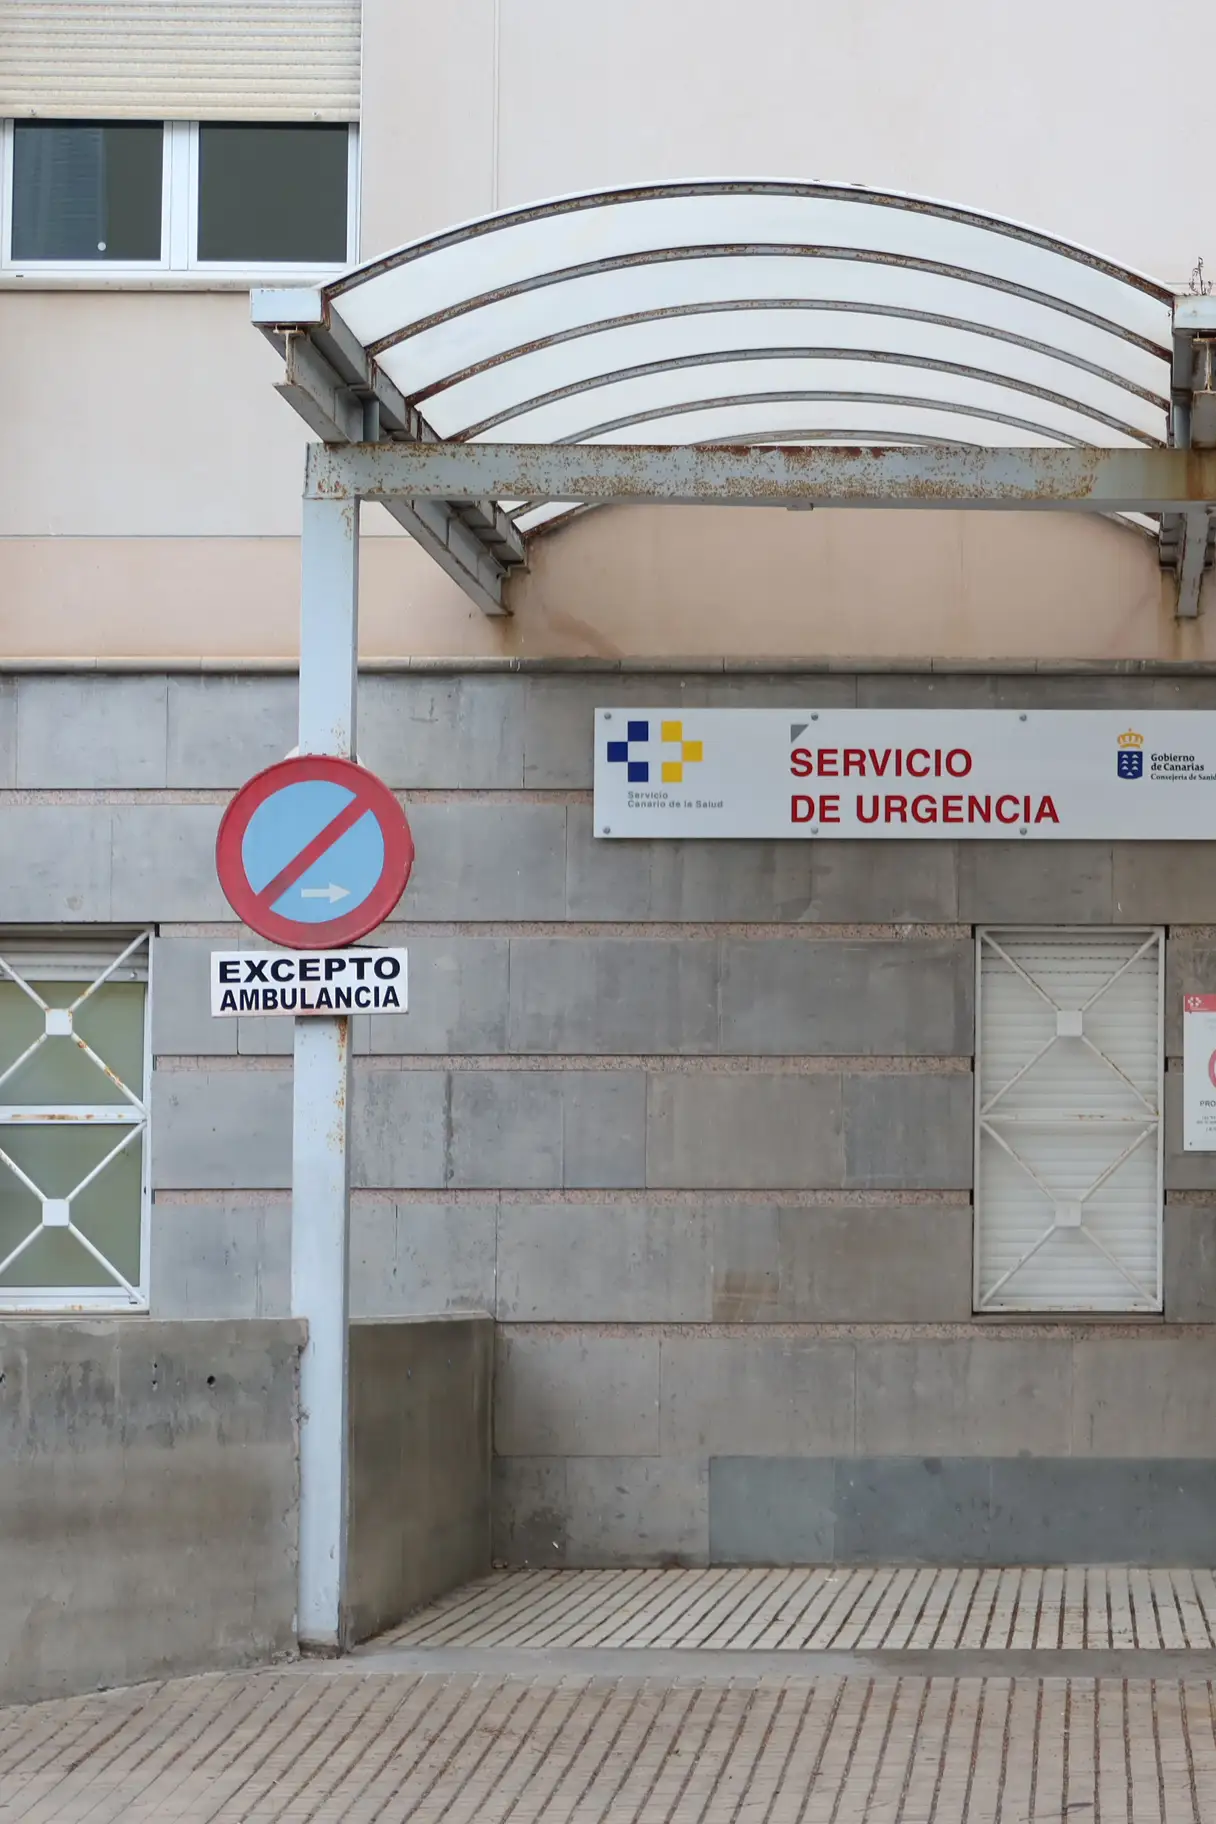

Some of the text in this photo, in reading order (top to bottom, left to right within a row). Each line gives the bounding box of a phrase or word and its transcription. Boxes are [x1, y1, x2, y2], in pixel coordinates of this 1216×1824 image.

[790, 748, 973, 777] SERVICIO
[1150, 753, 1195, 762] Gobierno
[1150, 763, 1205, 771] de Canarias
[627, 791, 668, 799] Servicio
[627, 800, 724, 808] Canario de la Salud
[791, 794, 1060, 824] DE URGENCIA
[219, 956, 401, 984] EXCEPTO
[220, 986, 400, 1011] AMBULANCIA
